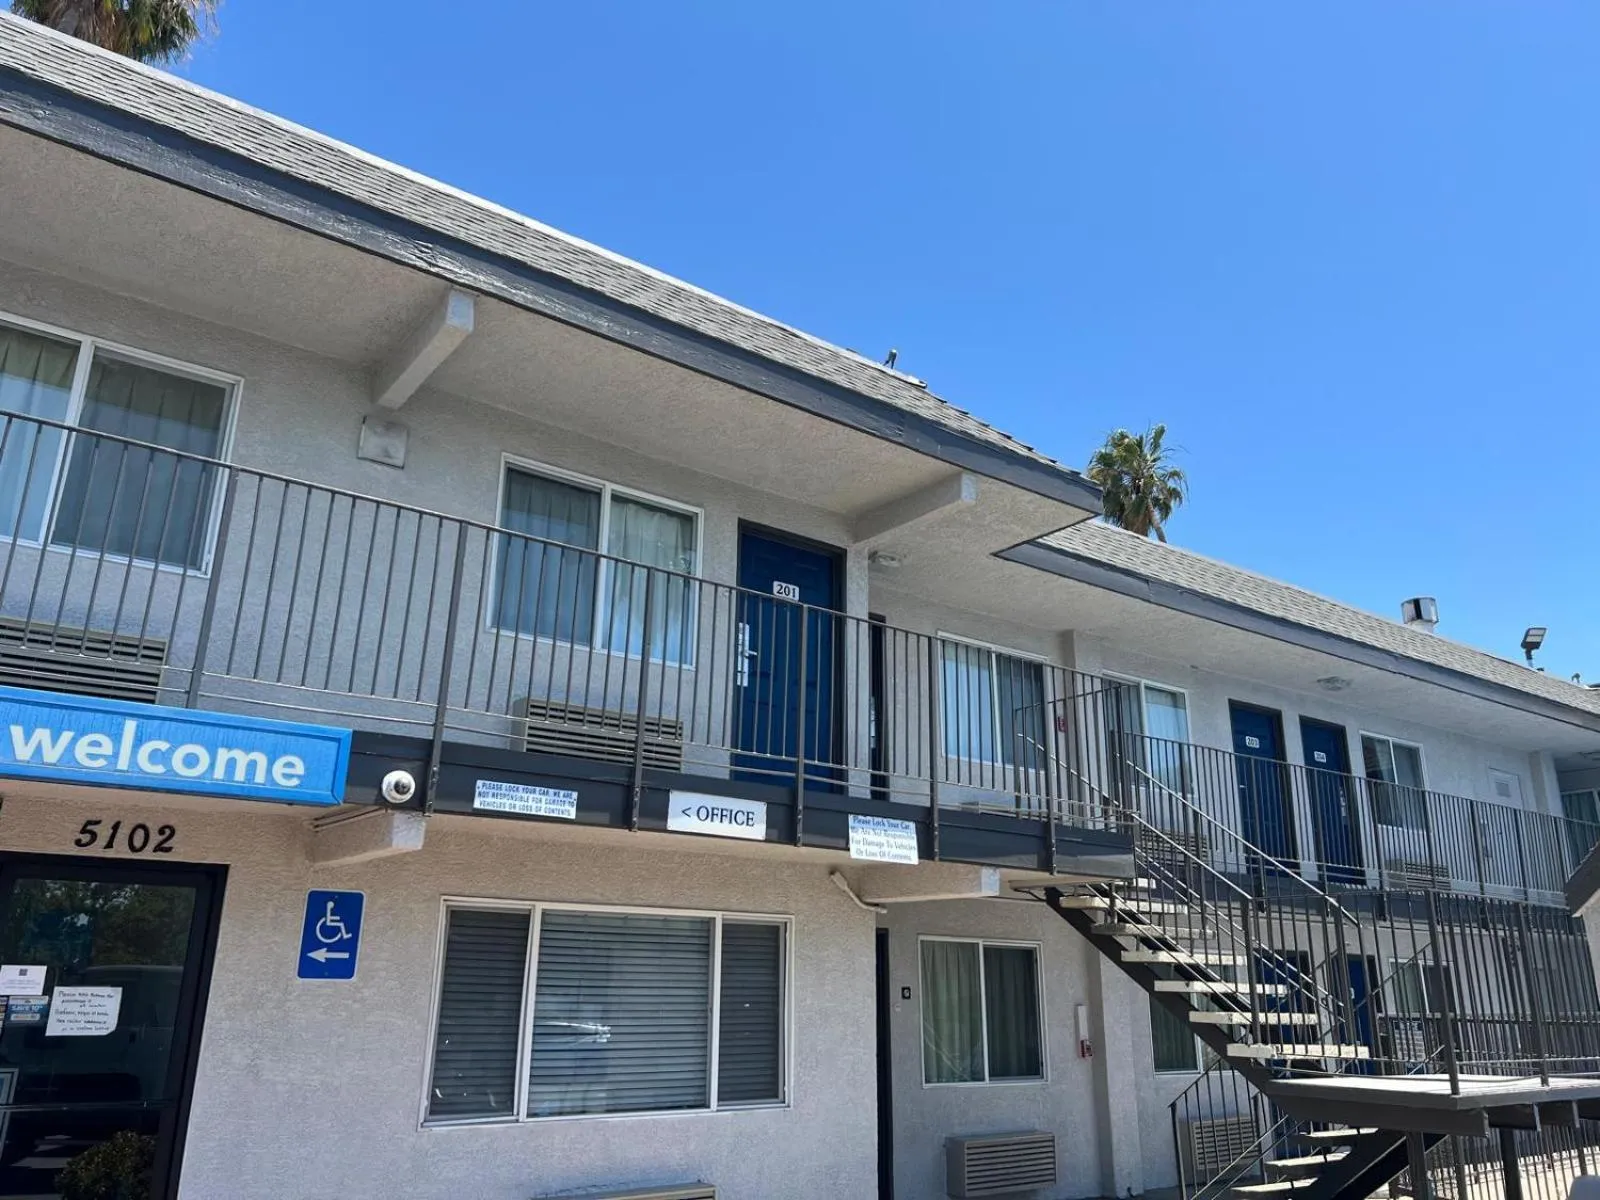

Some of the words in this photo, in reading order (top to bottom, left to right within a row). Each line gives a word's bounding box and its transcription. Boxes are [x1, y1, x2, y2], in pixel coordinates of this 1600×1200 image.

[776, 584, 796, 598] 201
[9, 719, 305, 787] welcome
[481, 782, 503, 791] PLEASE
[504, 784, 519, 792] LOCK
[522, 786, 536, 794] YOUR
[696, 805, 755, 827] OFFICE
[853, 816, 871, 825] Please
[872, 817, 886, 827] Lock
[74, 819, 176, 852] 5102
